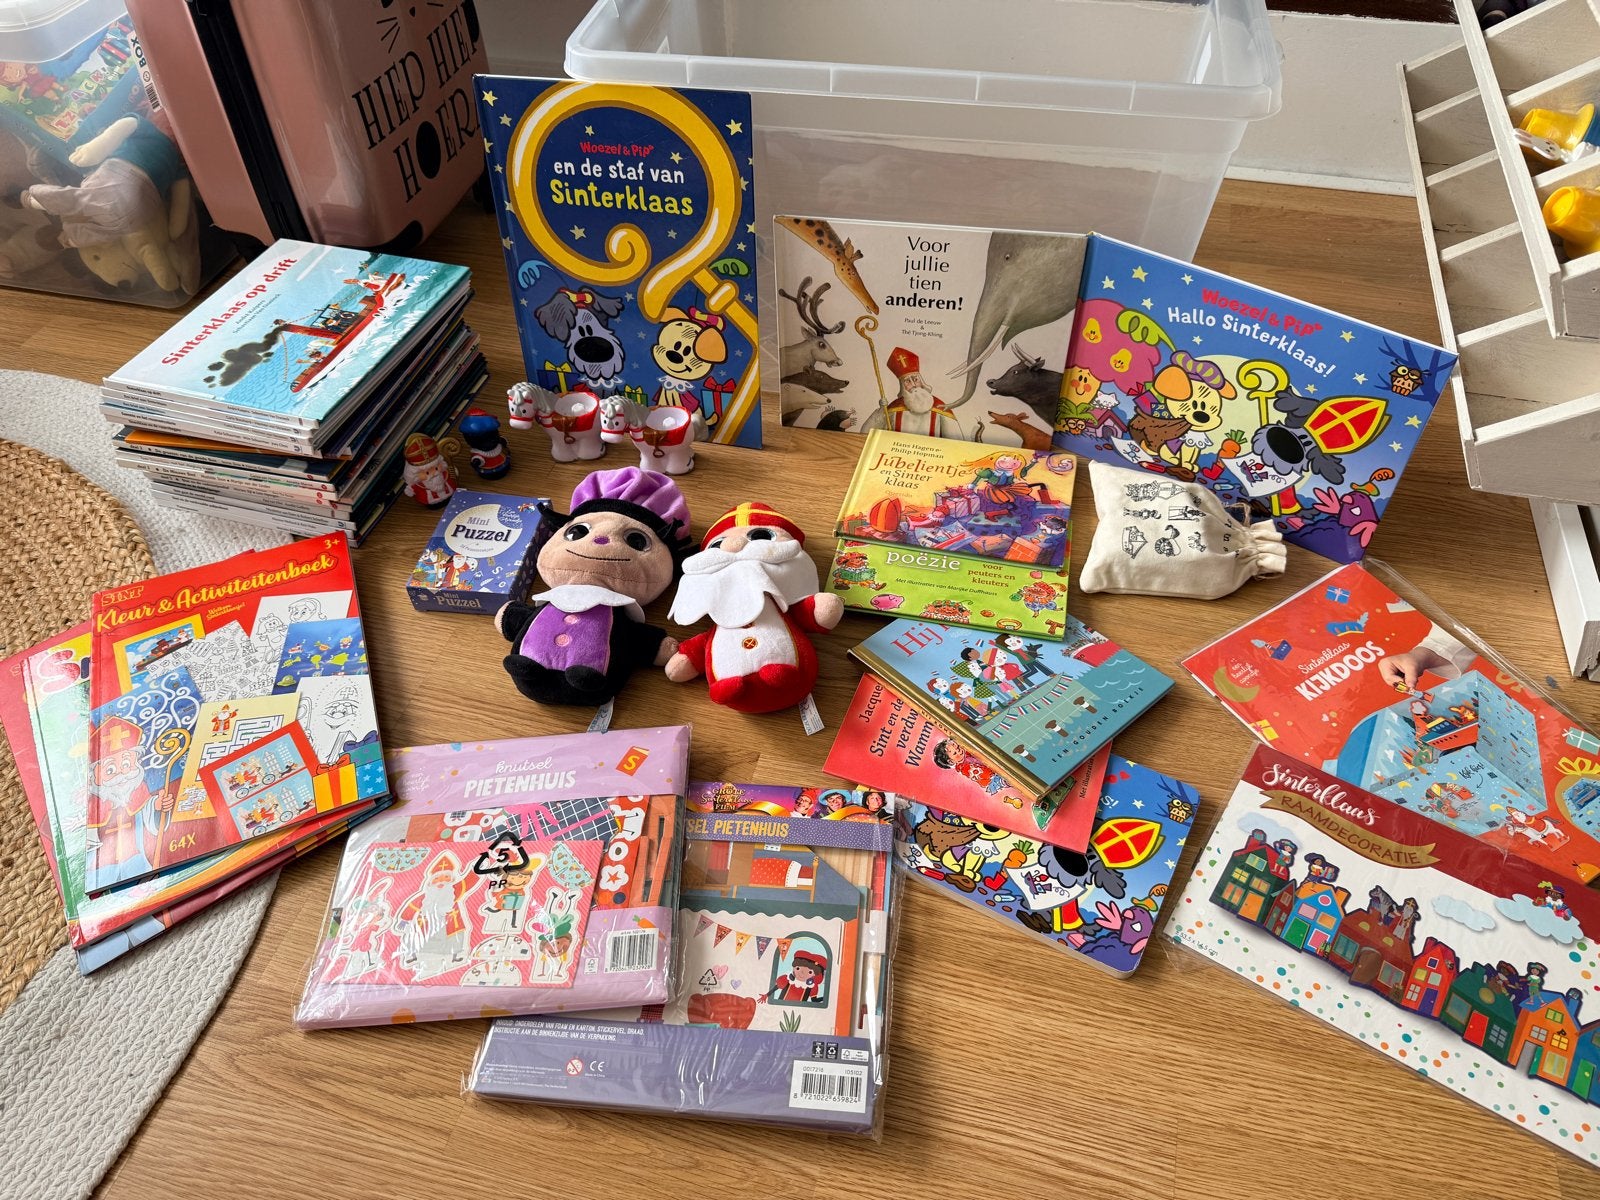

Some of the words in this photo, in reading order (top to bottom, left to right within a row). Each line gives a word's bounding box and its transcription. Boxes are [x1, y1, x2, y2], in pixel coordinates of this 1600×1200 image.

[352, 51, 425, 149] HIEP
[394, 88, 480, 203] HOER
[580, 142, 621, 155] Woezel
[554, 161, 575, 175] en
[581, 158, 602, 177] de
[609, 160, 644, 180] staf
[650, 168, 684, 183] van
[550, 179, 693, 215] Sinterklaas
[908, 236, 950, 253] Voor
[904, 256, 949, 274] jullie
[910, 275, 941, 290] tien
[885, 293, 963, 310] anderen!
[1202, 288, 1266, 321] Woezel
[1267, 313, 1280, 327] &
[162, 300, 247, 365] Sinterklaas
[246, 284, 267, 298] op
[264, 258, 297, 283] drift
[1167, 307, 1216, 327] Hallo
[1222, 314, 1336, 378] Sinterklaas!
[891, 447, 912, 456] Philip
[913, 449, 944, 459] Hopman
[912, 442, 934, 451] Hagen
[869, 453, 966, 478] Jubelientje
[885, 477, 920, 489] klaas
[893, 470, 933, 482] Sinter
[467, 517, 490, 526] Mini
[451, 524, 511, 542] Puzzel
[324, 539, 340, 549] 3+
[885, 551, 960, 570] poëzie
[968, 569, 1002, 579] peuters
[972, 577, 1009, 588] kleuters
[97, 605, 155, 632] Kleur
[158, 599, 175, 614] &
[177, 553, 335, 609] Activiteitenboek
[907, 579, 935, 588] illustraties
[102, 586, 144, 606] SINT
[436, 595, 481, 608] Puzzel
[890, 622, 944, 658] Hij
[1297, 642, 1350, 674] Sinterklaas
[1294, 640, 1385, 701] KIJKDOOS
[859, 683, 884, 723] Jacque
[891, 698, 904, 712] de
[888, 713, 899, 727] en
[896, 708, 919, 749] verdw
[869, 726, 892, 757] Sint
[905, 721, 934, 767] Wamm
[495, 756, 553, 774] knutsel
[1083, 754, 1096, 787] illustratie
[464, 770, 576, 798] PIETENHUIS
[1079, 786, 1088, 799] Met
[1261, 763, 1381, 826] Sinterklaas
[713, 820, 789, 838] PIETENHUIS
[1281, 795, 1420, 865] RAAMDECORATIE
[169, 833, 196, 852] 64X
[496, 848, 509, 862] 5
[489, 880, 507, 889] PP
[545, 1022, 555, 1030] VAN
[570, 1031, 579, 1039] VAN
